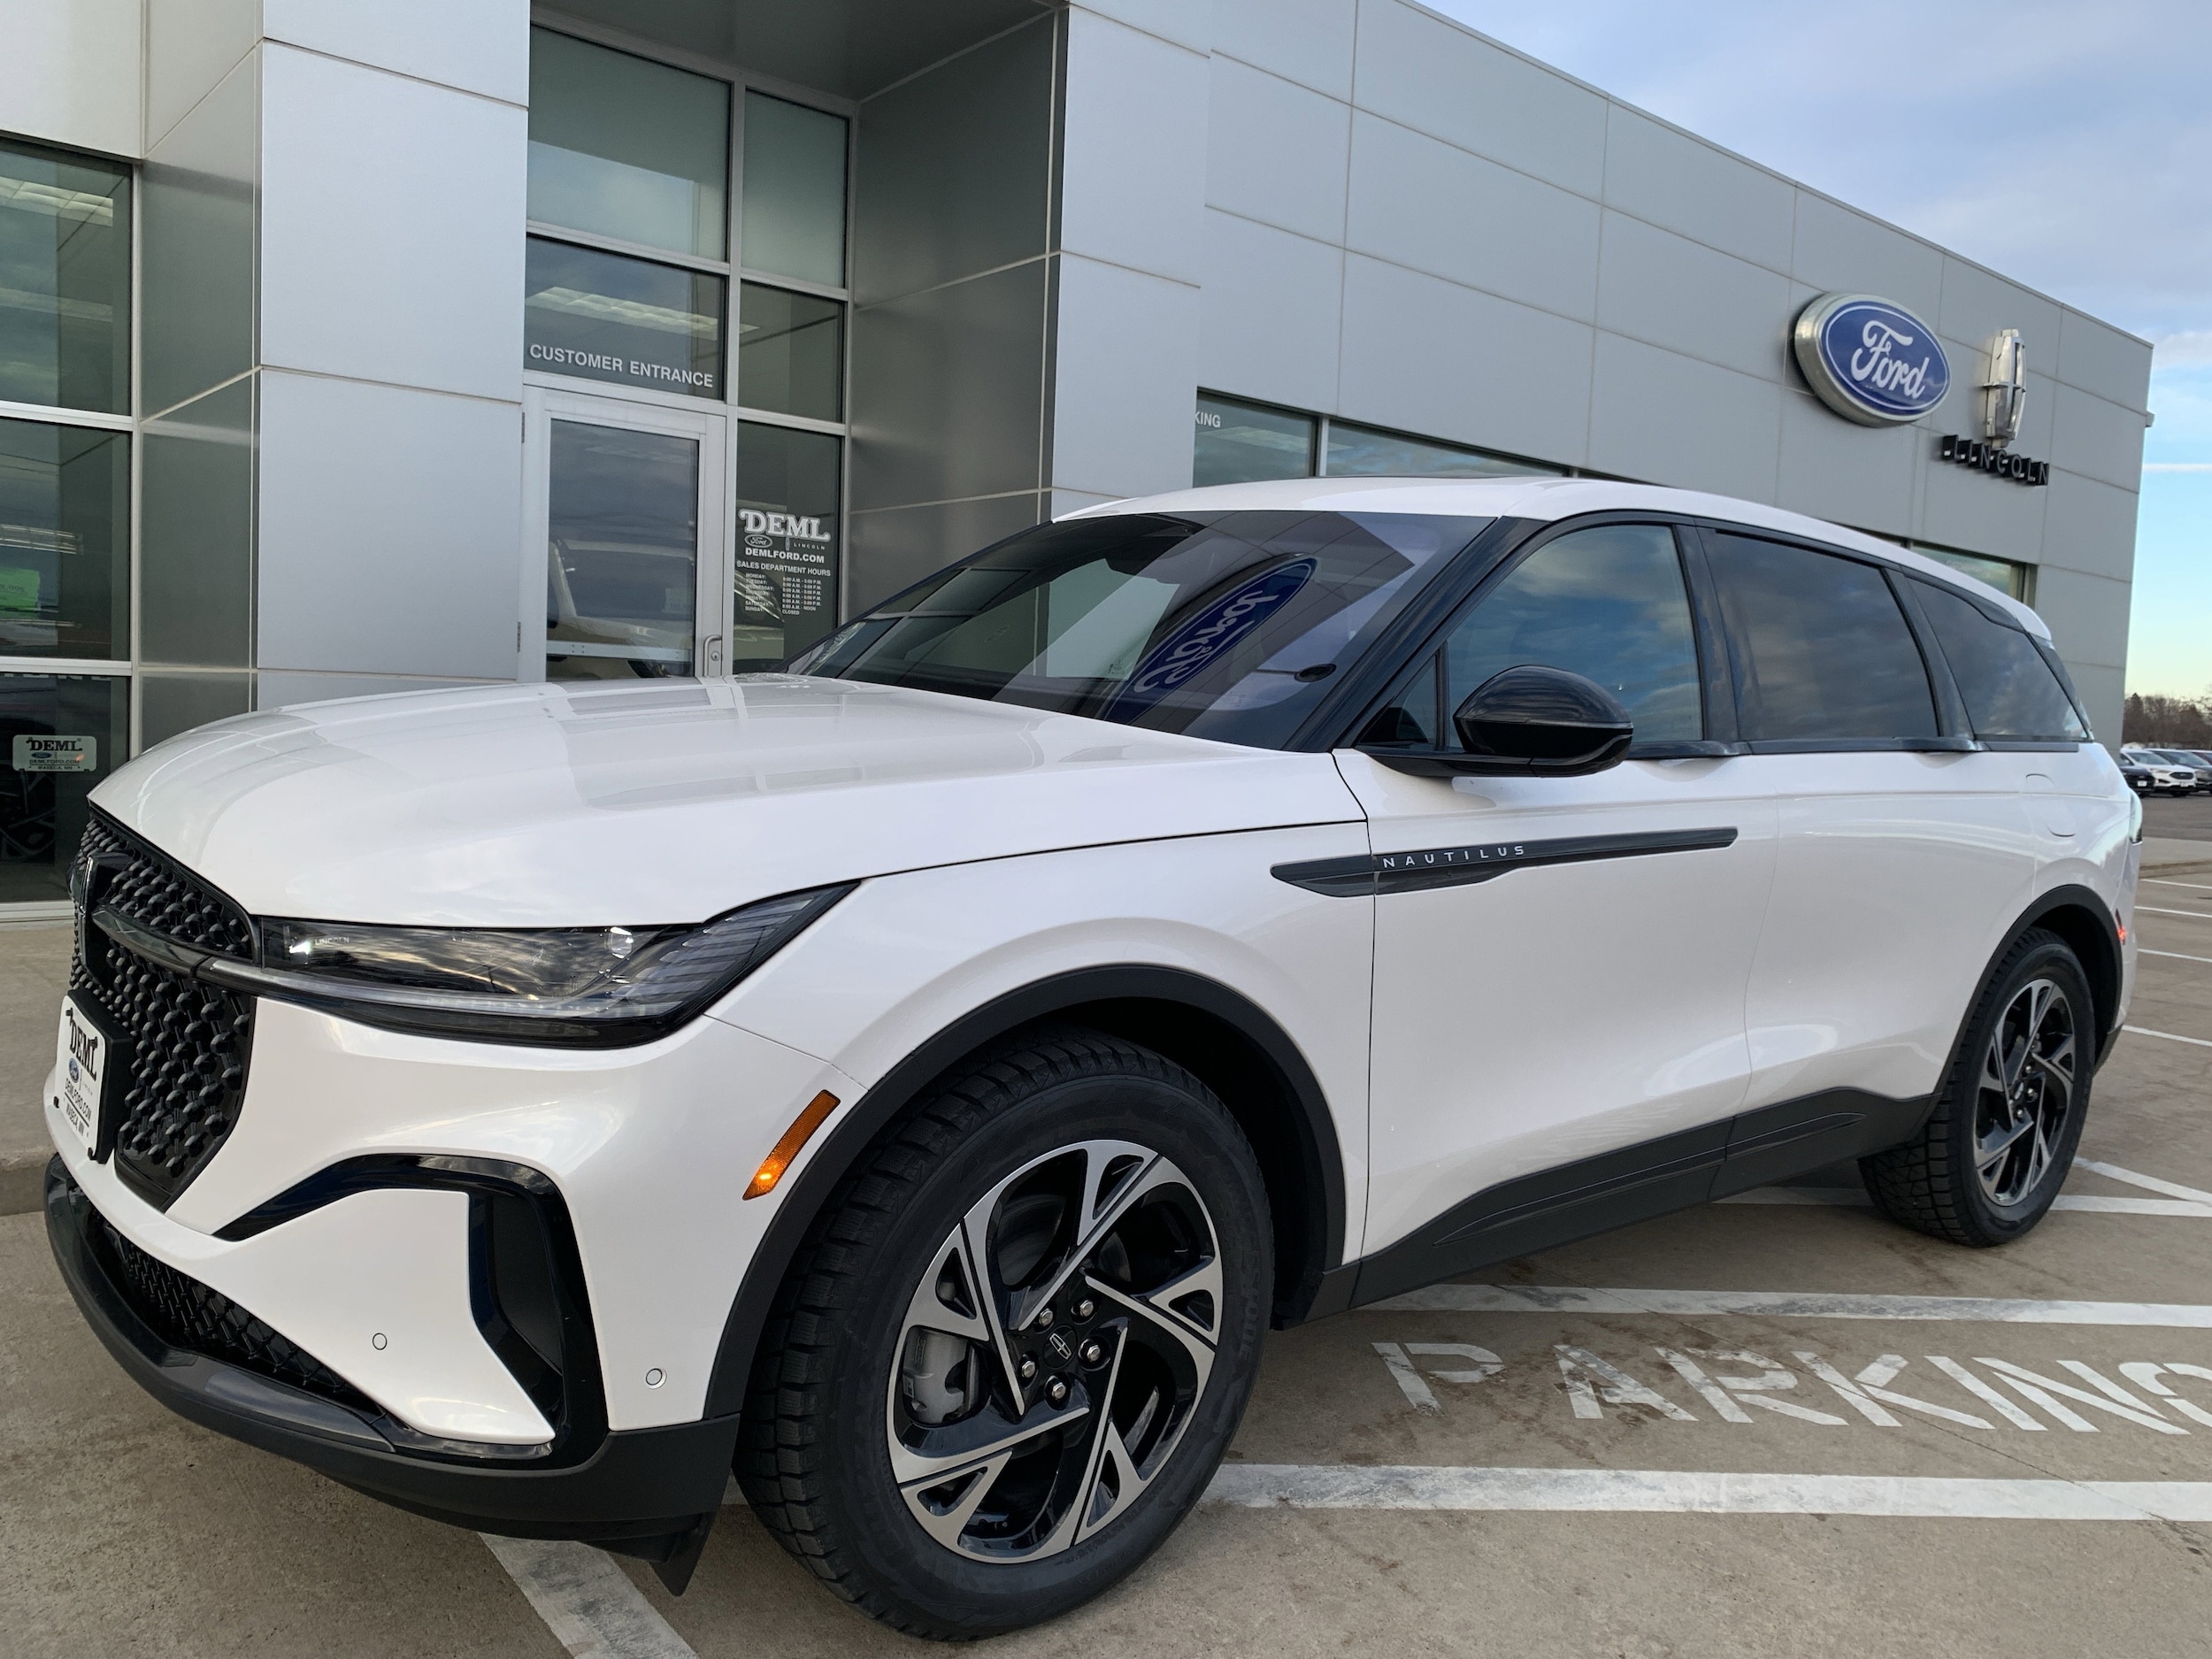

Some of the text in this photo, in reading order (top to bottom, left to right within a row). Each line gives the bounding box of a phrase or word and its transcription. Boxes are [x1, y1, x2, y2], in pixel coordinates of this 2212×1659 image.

[529, 344, 713, 388] CUSTOMER ENTRANCE
[1850, 319, 1930, 399] Ford
[1942, 434, 2050, 486] LINCOLN
[739, 509, 831, 542] DEML
[736, 560, 831, 577] SALES DEPARTMENT HOURS
[745, 548, 825, 564] DEMLFORD.COM
[26, 740, 83, 751] DEML
[1382, 846, 1525, 869] NAUTILUS
[69, 1016, 96, 1081] DEML
[65, 1078, 92, 1121] DEMLFORD.COM
